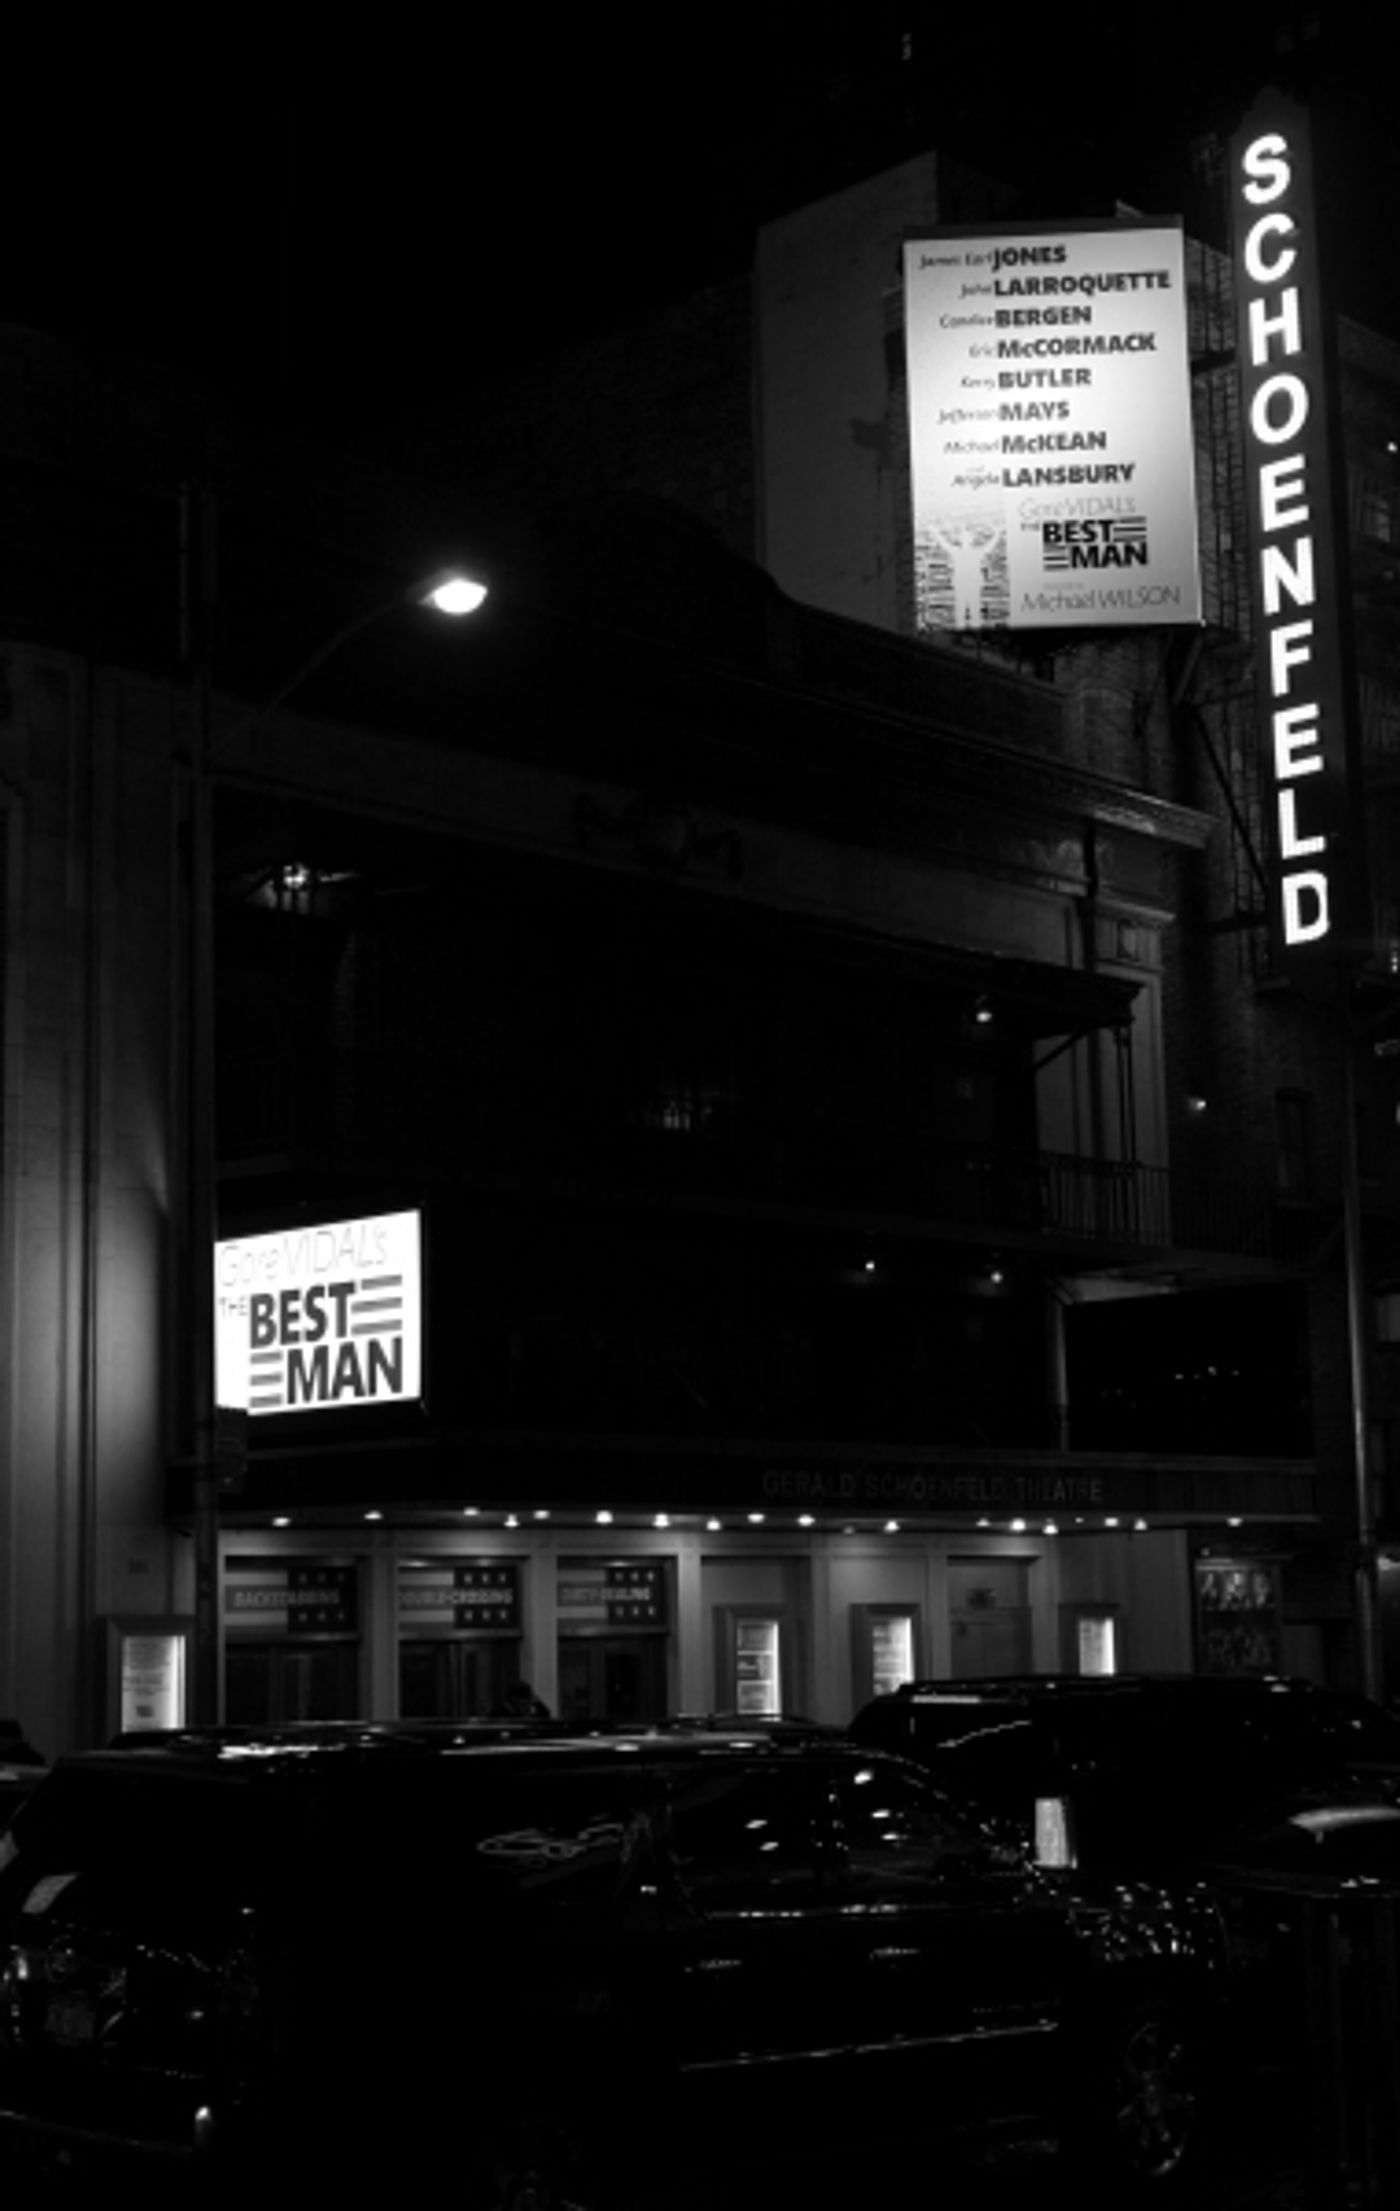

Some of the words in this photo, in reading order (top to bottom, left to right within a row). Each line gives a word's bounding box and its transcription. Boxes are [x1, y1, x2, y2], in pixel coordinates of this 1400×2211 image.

[992, 245, 1067, 272] JONES
[994, 269, 1171, 297] LARROQUETTE
[995, 306, 1091, 327] BERGEN
[998, 333, 1156, 358] McCORMACK
[998, 368, 1092, 389] BUTLER
[999, 400, 1070, 421] MAYS
[1002, 431, 1107, 454] McKEAN
[1003, 464, 1135, 487] LANSBURY
[1043, 519, 1115, 543] BEST
[1241, 133, 1331, 945] SCHOENFELD
[1071, 542, 1148, 569] MAN
[1098, 585, 1181, 609] WILSON
[250, 1281, 357, 1350] BEST
[287, 1336, 403, 1405] MAN
[761, 1468, 857, 1499] GERALD
[865, 1472, 1005, 1502] SCHOENFELD
